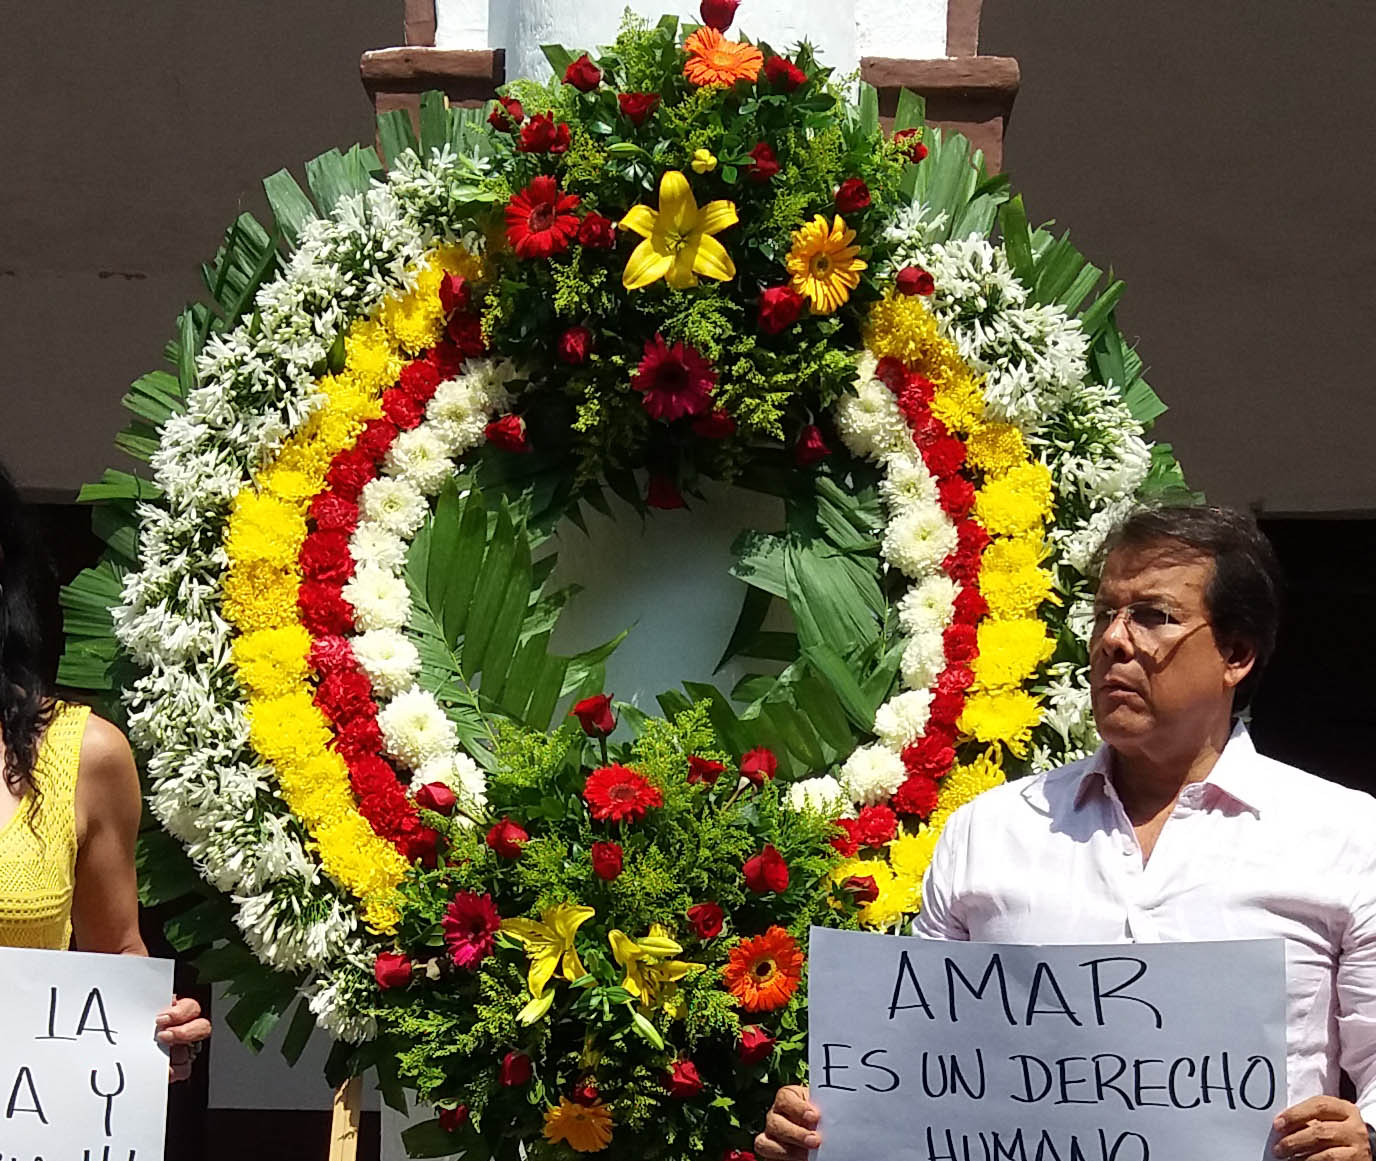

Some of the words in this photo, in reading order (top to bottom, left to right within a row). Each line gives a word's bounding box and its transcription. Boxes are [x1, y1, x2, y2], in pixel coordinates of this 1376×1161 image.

[36, 987, 118, 1044] LA
[888, 950, 1162, 1028] AMAR
[91, 1062, 124, 1137] Y
[822, 1043, 900, 1092] ES
[922, 1048, 986, 1101] UN
[1010, 1051, 1275, 1111] DERECHO
